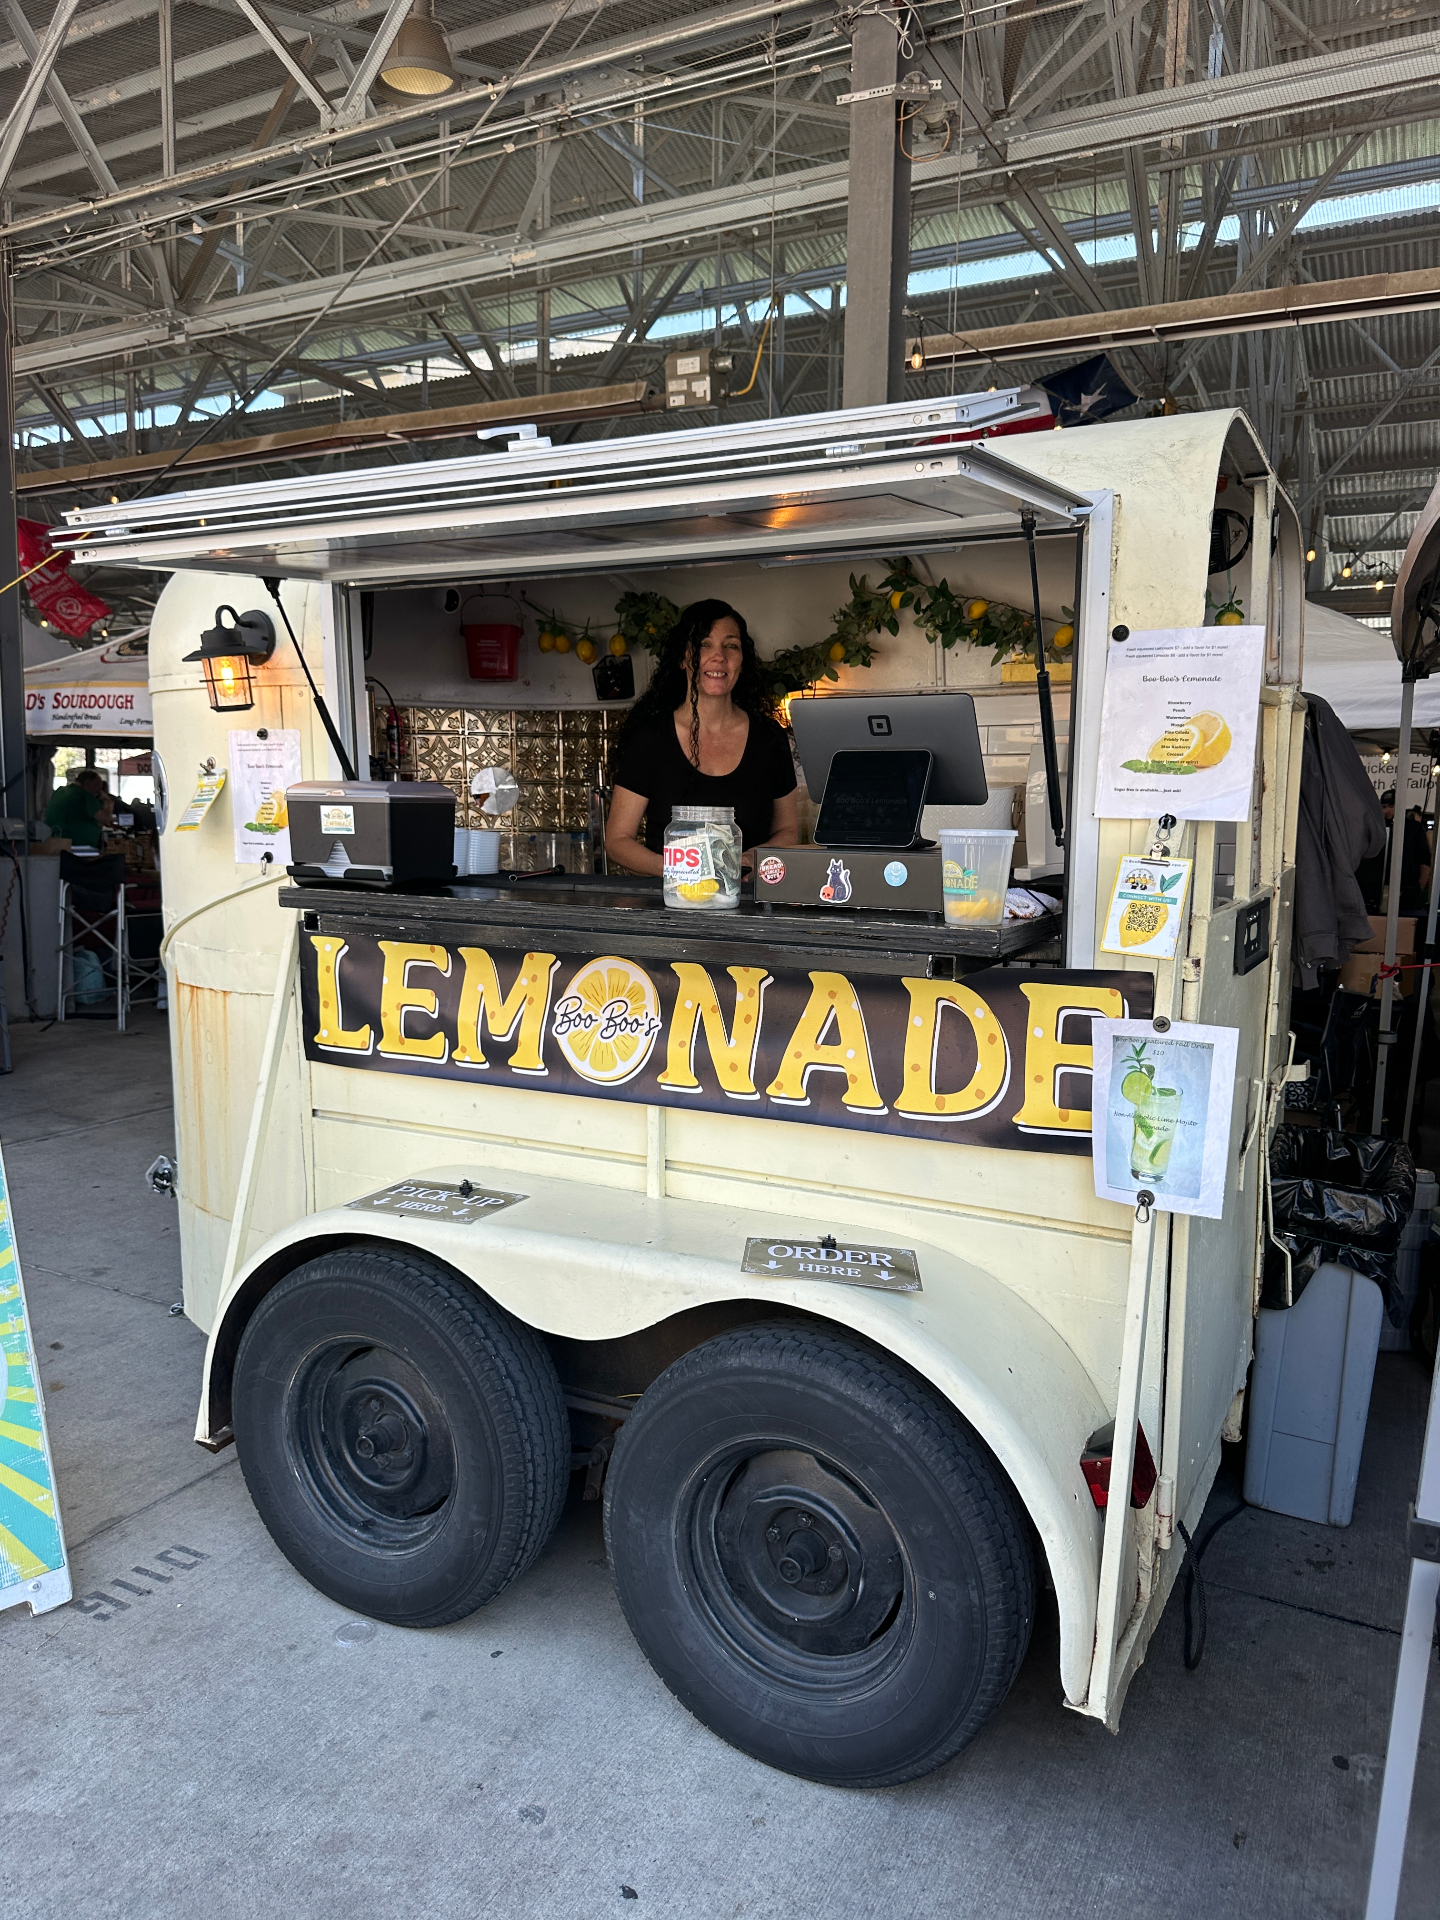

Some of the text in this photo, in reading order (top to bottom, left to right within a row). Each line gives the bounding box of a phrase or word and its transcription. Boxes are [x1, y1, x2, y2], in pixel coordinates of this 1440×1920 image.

[1181, 674, 1222, 682] Lemonade
[52, 692, 135, 710] SOURDOUGH
[1364, 762, 1398, 774] icke
[871, 797, 908, 805] Lemonade
[554, 995, 660, 1040] Boo Boo's
[1157, 1116, 1175, 1124] Lime
[1175, 1118, 1199, 1127] Mojito
[387, 1185, 505, 1208] PICK-UP
[394, 1200, 449, 1213] HERE
[767, 1245, 896, 1268] ORDER
[798, 1262, 862, 1278] HERE
